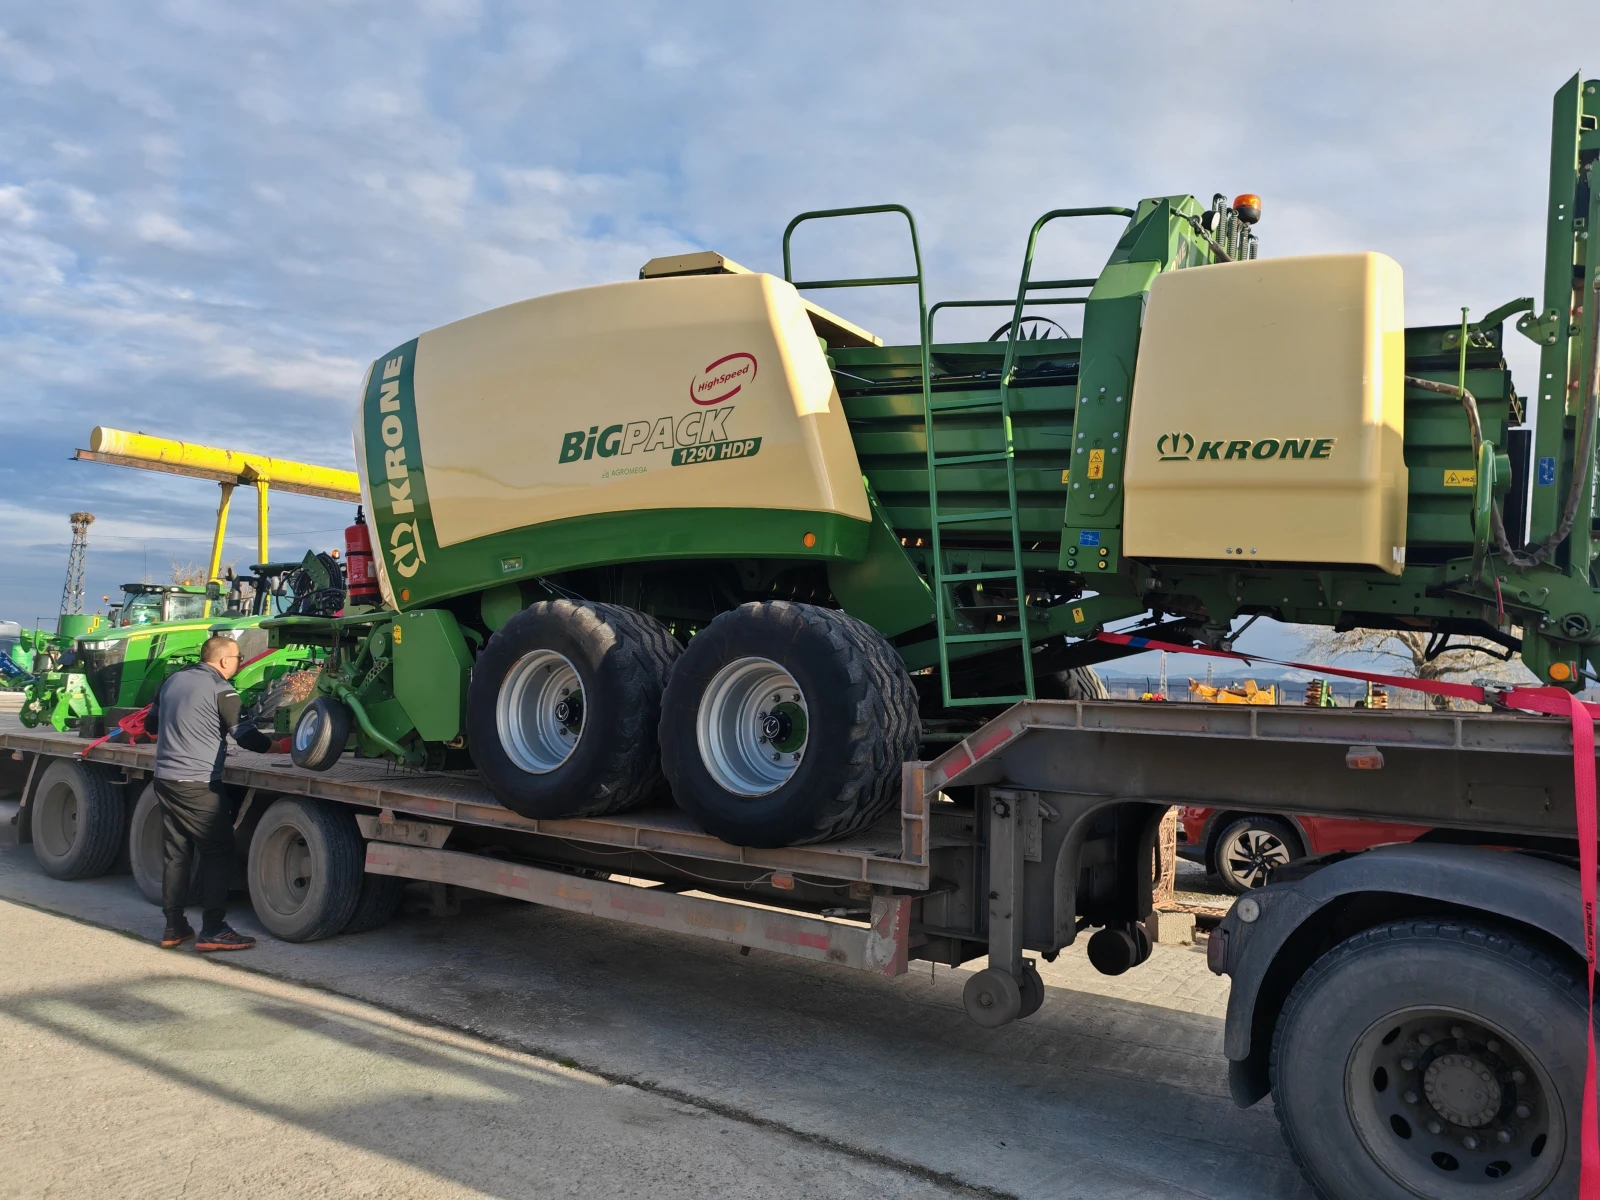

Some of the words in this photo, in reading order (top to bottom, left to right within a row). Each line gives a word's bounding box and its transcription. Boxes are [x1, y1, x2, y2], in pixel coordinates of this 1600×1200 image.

[698, 363, 750, 392] HighSpeed
[380, 355, 414, 515] KRONE
[680, 445, 716, 464] 1290
[720, 440, 755, 459] HDP
[1195, 438, 1336, 461] KRONE
[611, 466, 648, 477] AGROMEGA
